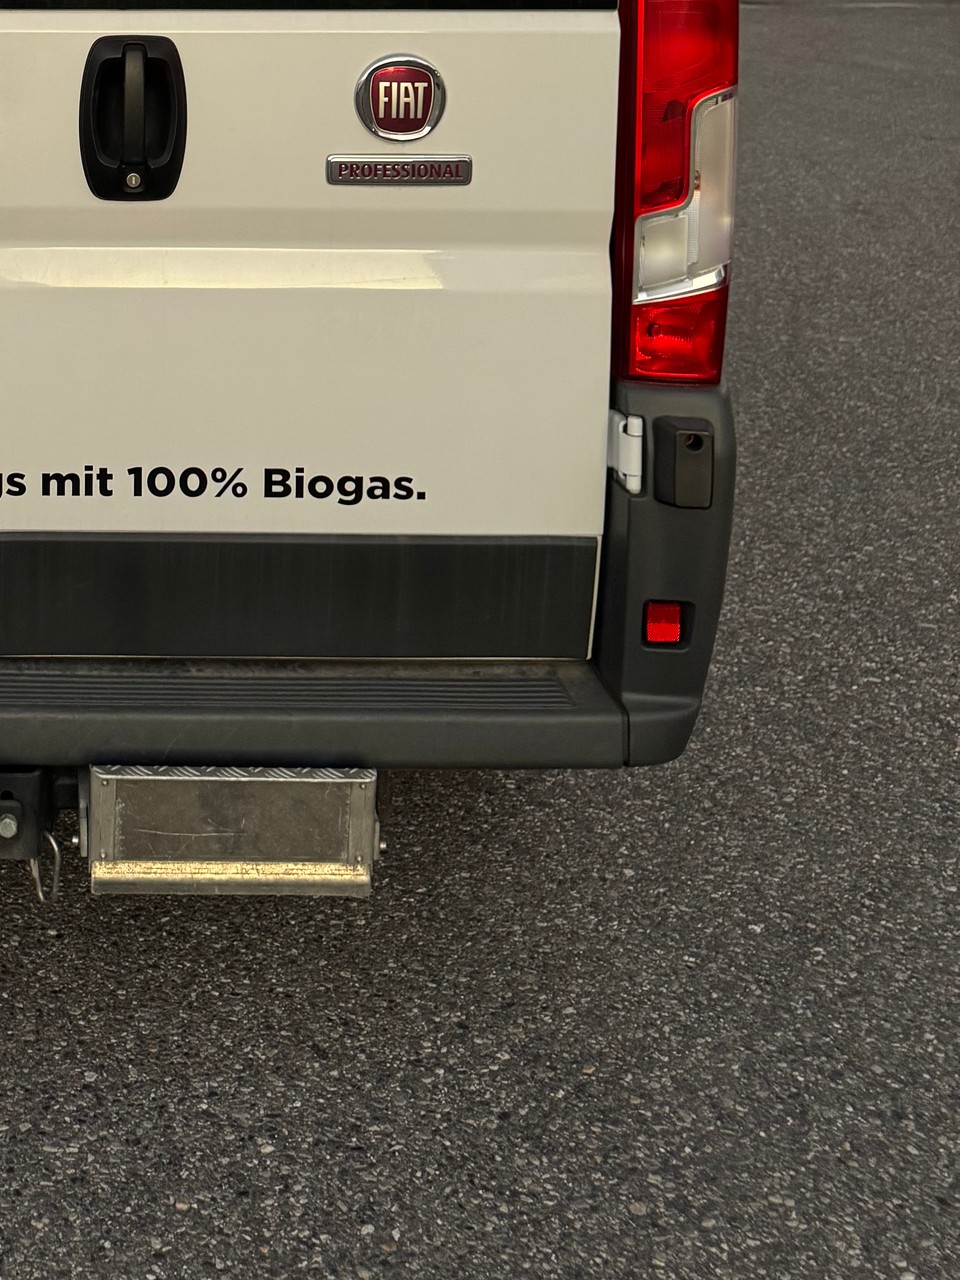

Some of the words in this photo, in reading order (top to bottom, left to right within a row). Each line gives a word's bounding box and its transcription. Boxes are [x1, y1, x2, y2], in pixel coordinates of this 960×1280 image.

[378, 81, 428, 119] FIAT
[338, 163, 463, 179] PROFESSIONAL
[41, 465, 113, 497] mit
[127, 466, 248, 499] 100%
[263, 467, 427, 506] Biogas.
